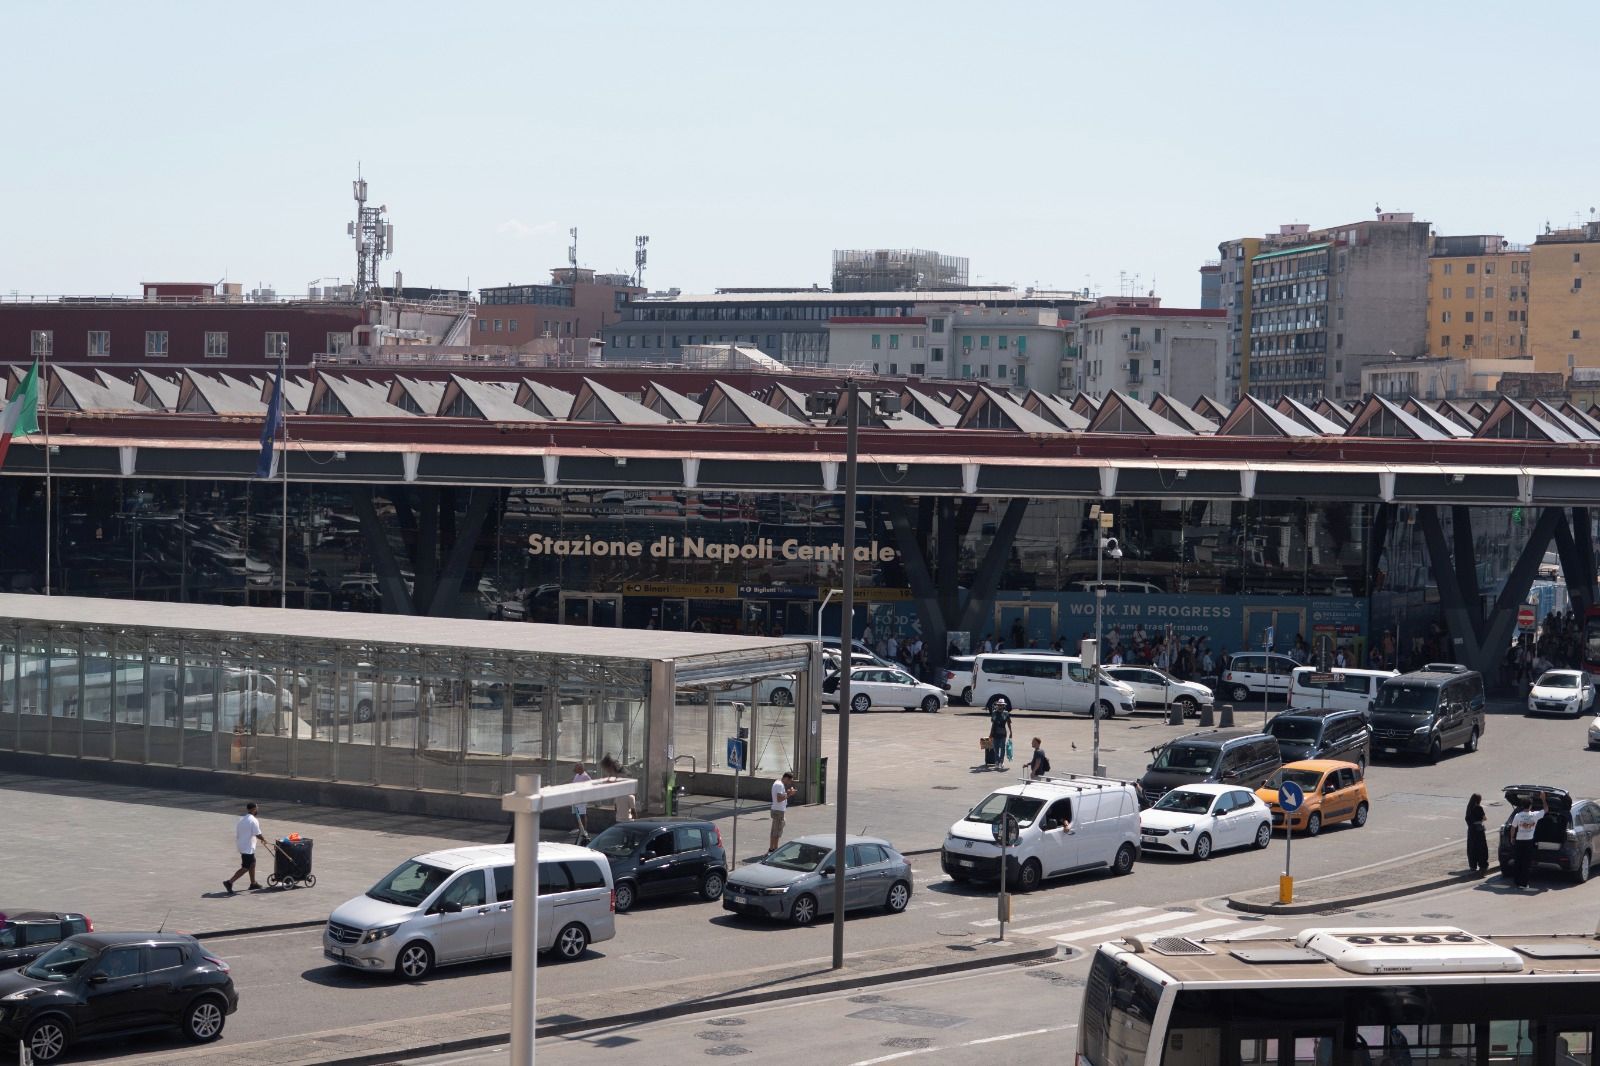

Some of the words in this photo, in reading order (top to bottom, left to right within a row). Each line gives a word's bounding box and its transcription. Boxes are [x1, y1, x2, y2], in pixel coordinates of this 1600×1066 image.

[528, 533, 642, 557] Stazione
[651, 535, 675, 557] di
[683, 537, 773, 563] Napoli
[643, 584, 669, 593] Binari
[1122, 604, 1141, 616] IN
[1147, 605, 1231, 618] PROGRESS
